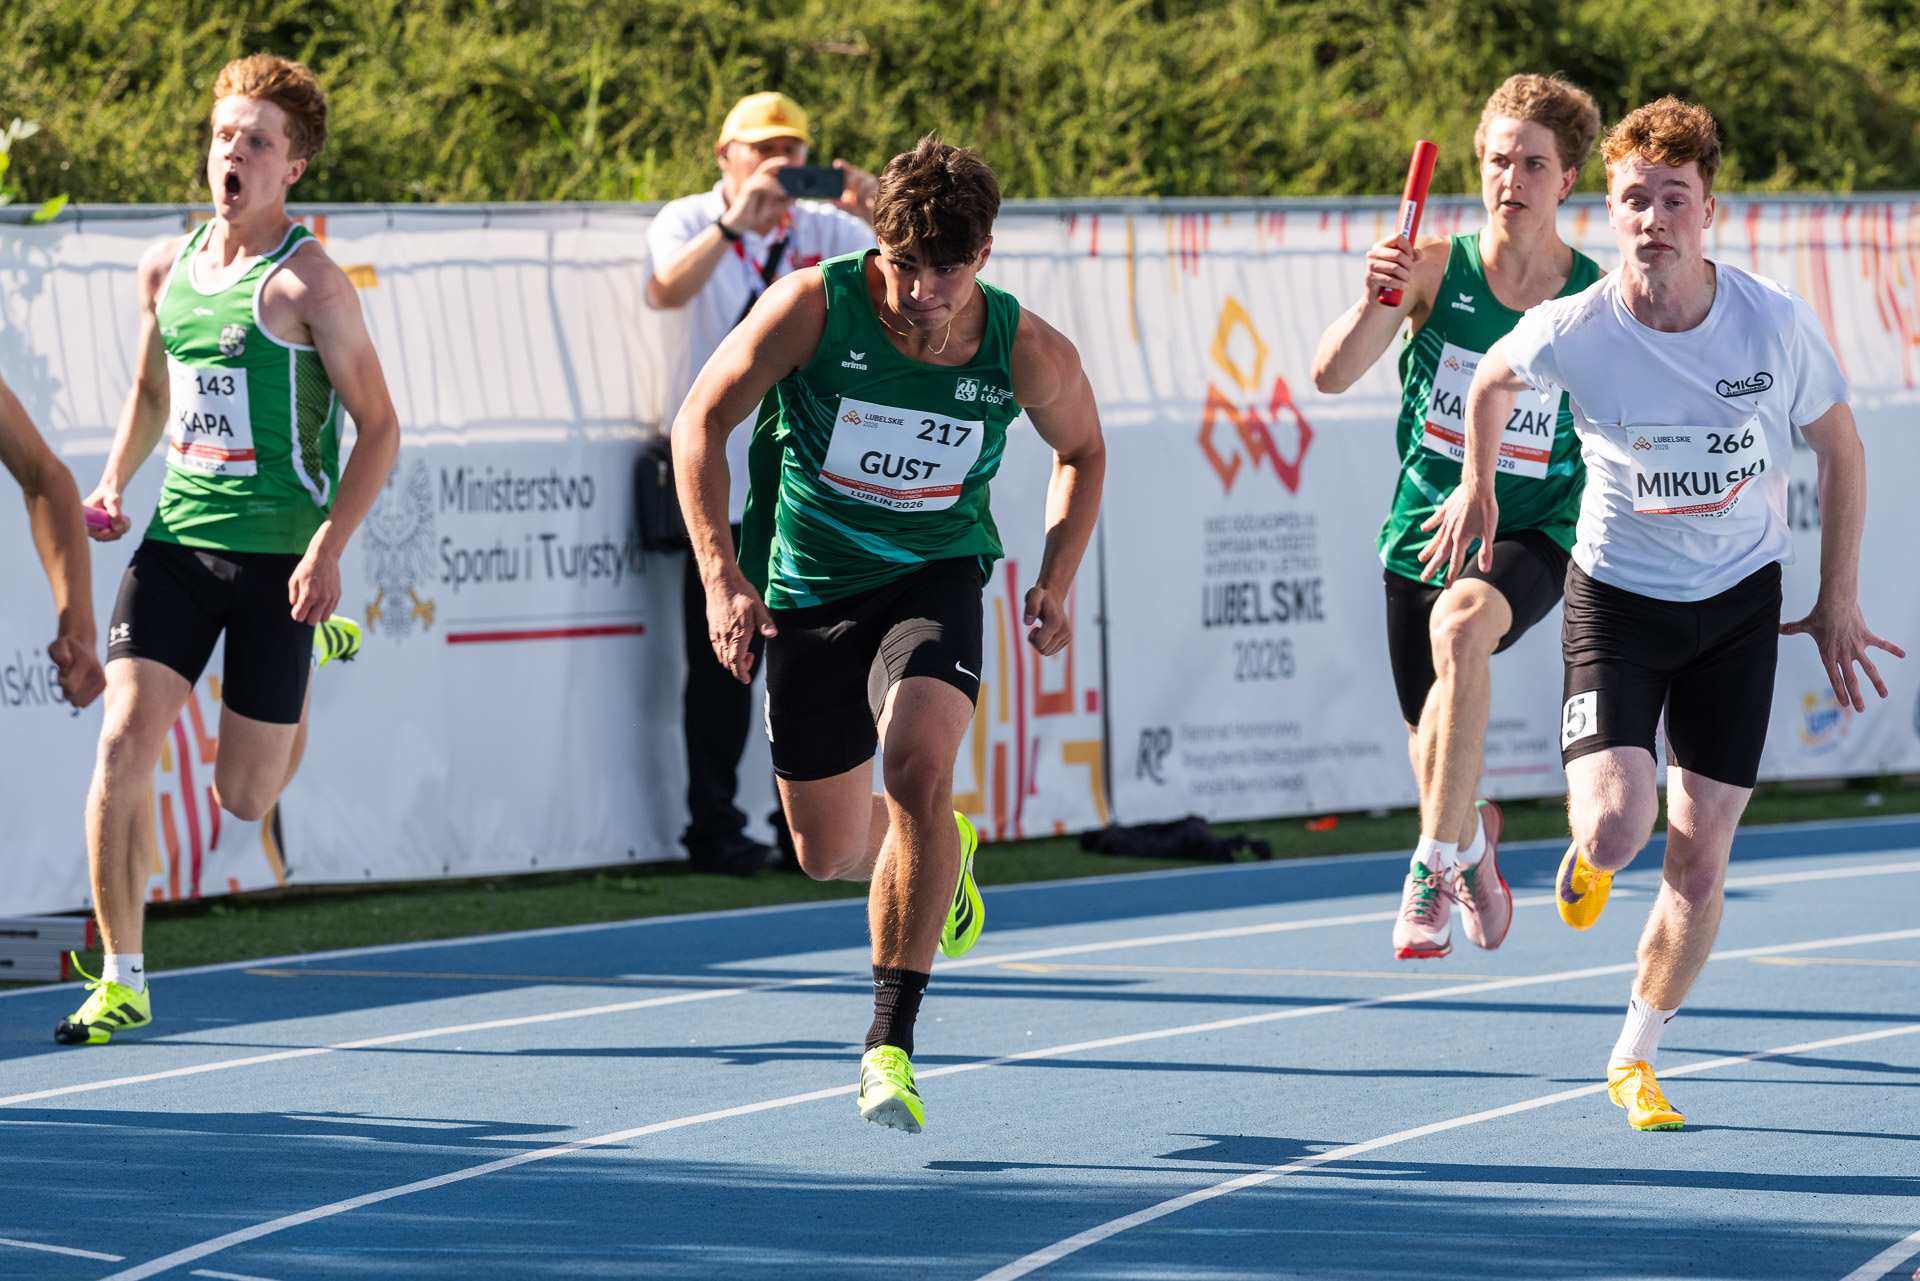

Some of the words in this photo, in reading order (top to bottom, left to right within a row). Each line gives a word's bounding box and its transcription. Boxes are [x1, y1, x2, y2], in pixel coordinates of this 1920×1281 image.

[841, 360, 867, 371] erima
[195, 376, 235, 396] 143
[176, 407, 235, 438] KAPA
[864, 413, 905, 426] LUBELSKIE
[916, 419, 972, 448] 217
[1706, 428, 1754, 454] 266
[860, 450, 941, 481] GUST
[1637, 459, 1765, 498] MIKULSKI
[440, 465, 596, 514] Ministerstwo
[851, 490, 893, 507] LUBLIN
[894, 500, 924, 509] 2026
[439, 534, 519, 594] Sportu
[1233, 637, 1296, 682] 2026
[1567, 697, 1586, 738] 5
